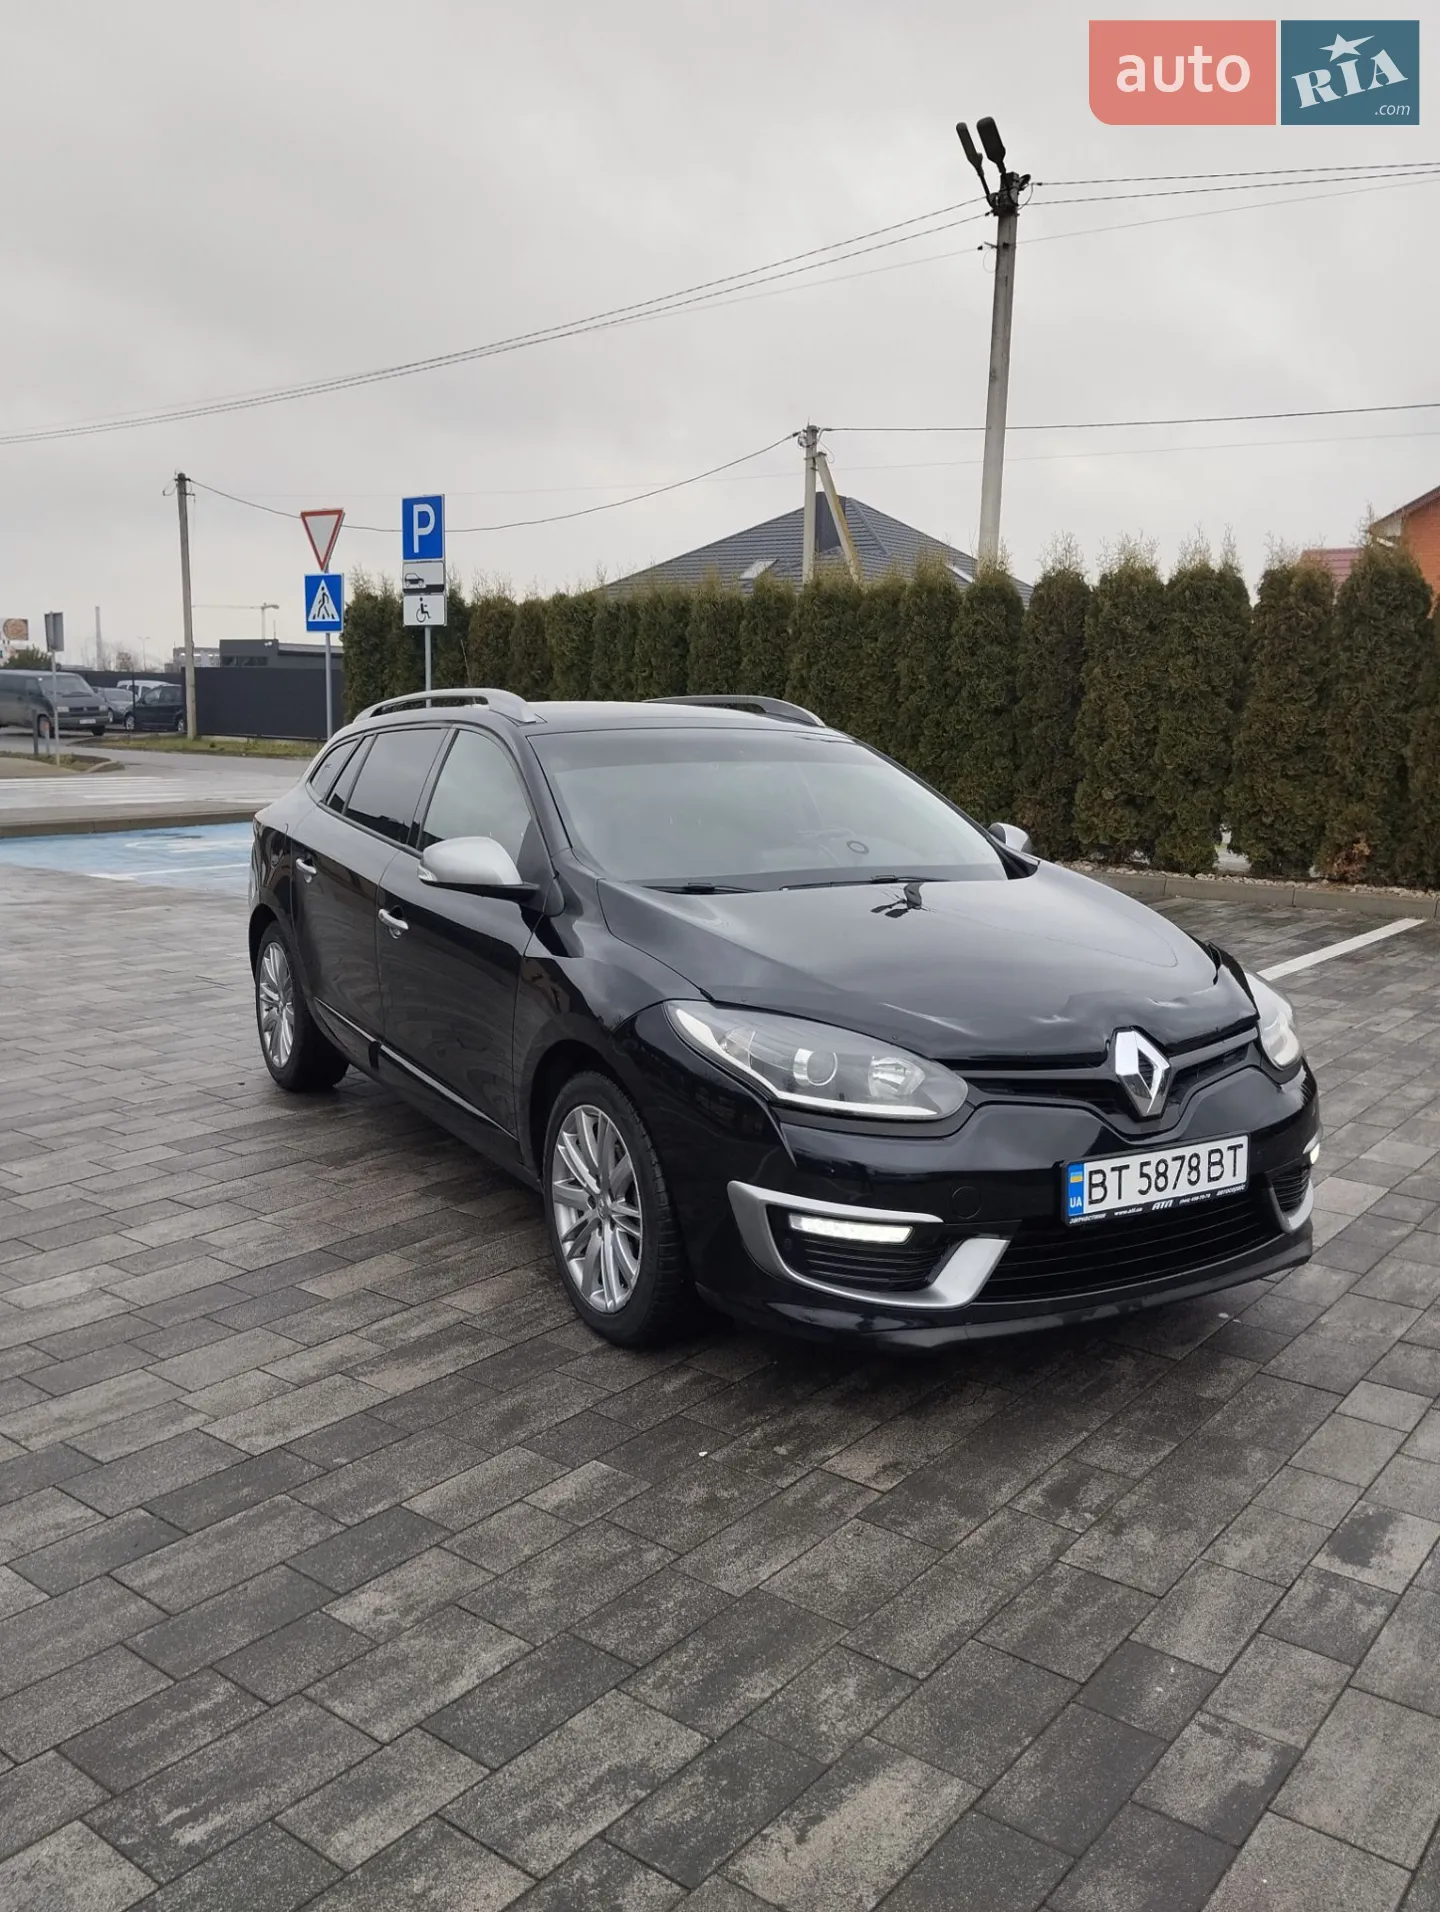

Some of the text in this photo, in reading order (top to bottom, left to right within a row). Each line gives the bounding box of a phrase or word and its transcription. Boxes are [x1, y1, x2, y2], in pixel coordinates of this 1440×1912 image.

[413, 503, 435, 553] P
[1088, 1143, 1244, 1206] BT 5878 BT
[1070, 1196, 1082, 1208] UA
